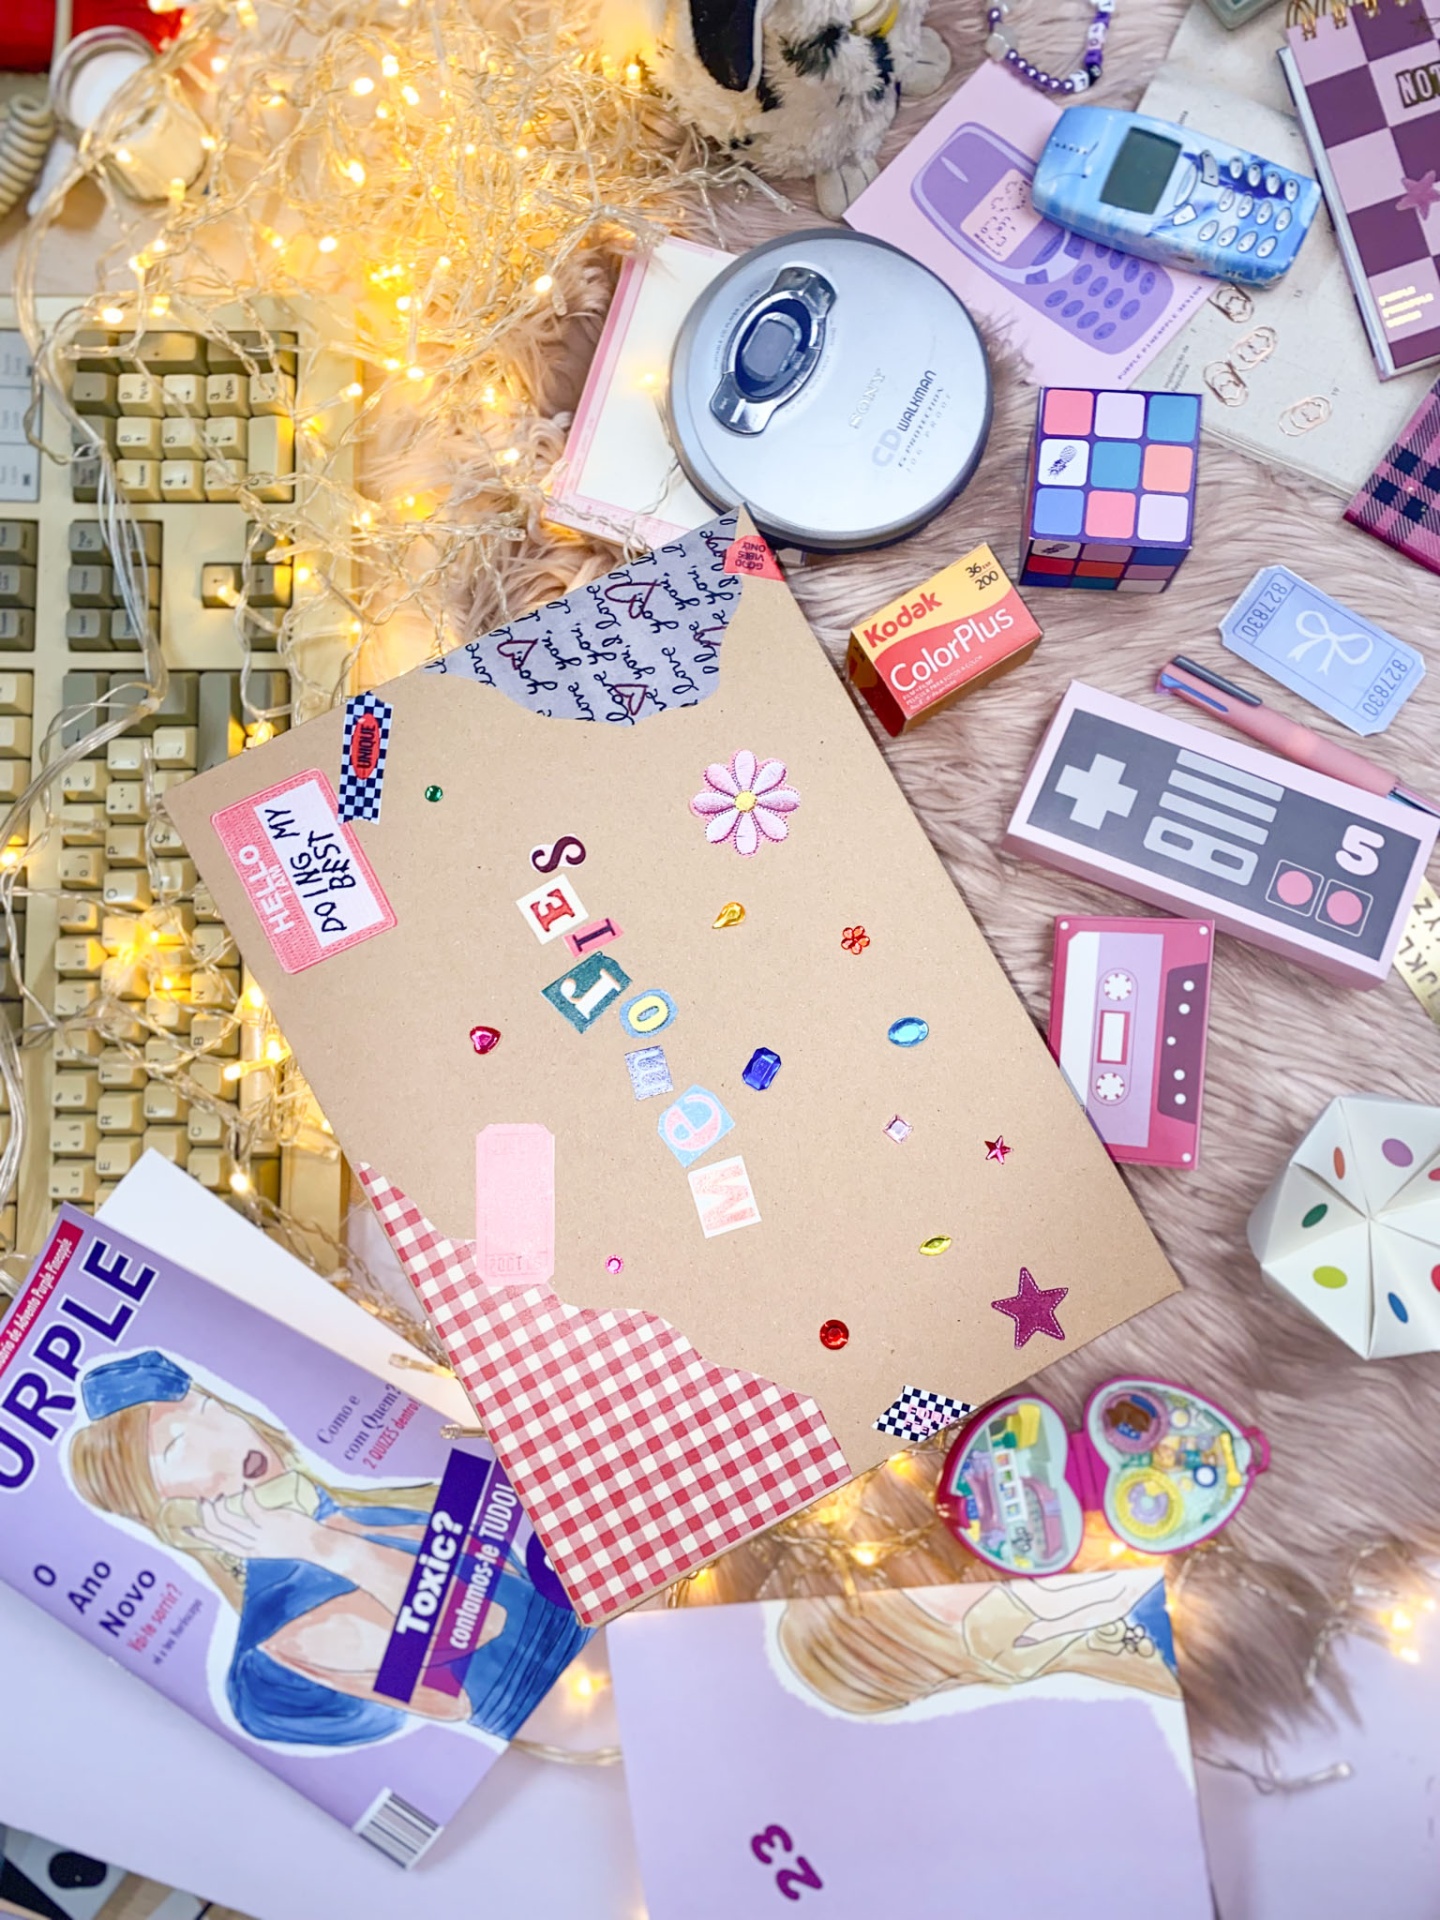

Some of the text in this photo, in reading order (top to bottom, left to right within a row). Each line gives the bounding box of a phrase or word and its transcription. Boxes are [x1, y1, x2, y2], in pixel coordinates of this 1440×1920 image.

[848, 368, 885, 429] SONY
[871, 370, 937, 467] CD WALKMAN
[735, 559, 764, 570] GOOD
[965, 562, 982, 578] 36
[975, 570, 1000, 591] 200
[863, 592, 943, 649] Kodak
[1241, 581, 1288, 638] 827830
[890, 608, 1015, 692] ColorPlus
[1362, 658, 1409, 717] 827830
[357, 723, 377, 769] UNIQUE
[264, 809, 300, 840] MY
[1335, 825, 1385, 876] 5
[238, 844, 296, 934] HELLO
[307, 830, 356, 889] BEST
[31, 1272, 55, 1300] Purple
[44, 1238, 73, 1274] Pineapple
[317, 1394, 361, 1445] Como e
[344, 1383, 403, 1462] com Quem?
[363, 1397, 421, 1470] 2 QUIZES dentro!
[33, 1563, 57, 1588] O
[67, 1561, 111, 1616] Ano
[396, 1511, 463, 1635] Toxic?
[449, 1541, 500, 1650] contamos-te
[98, 1570, 156, 1638] Novo
[751, 1824, 823, 1901] 23
